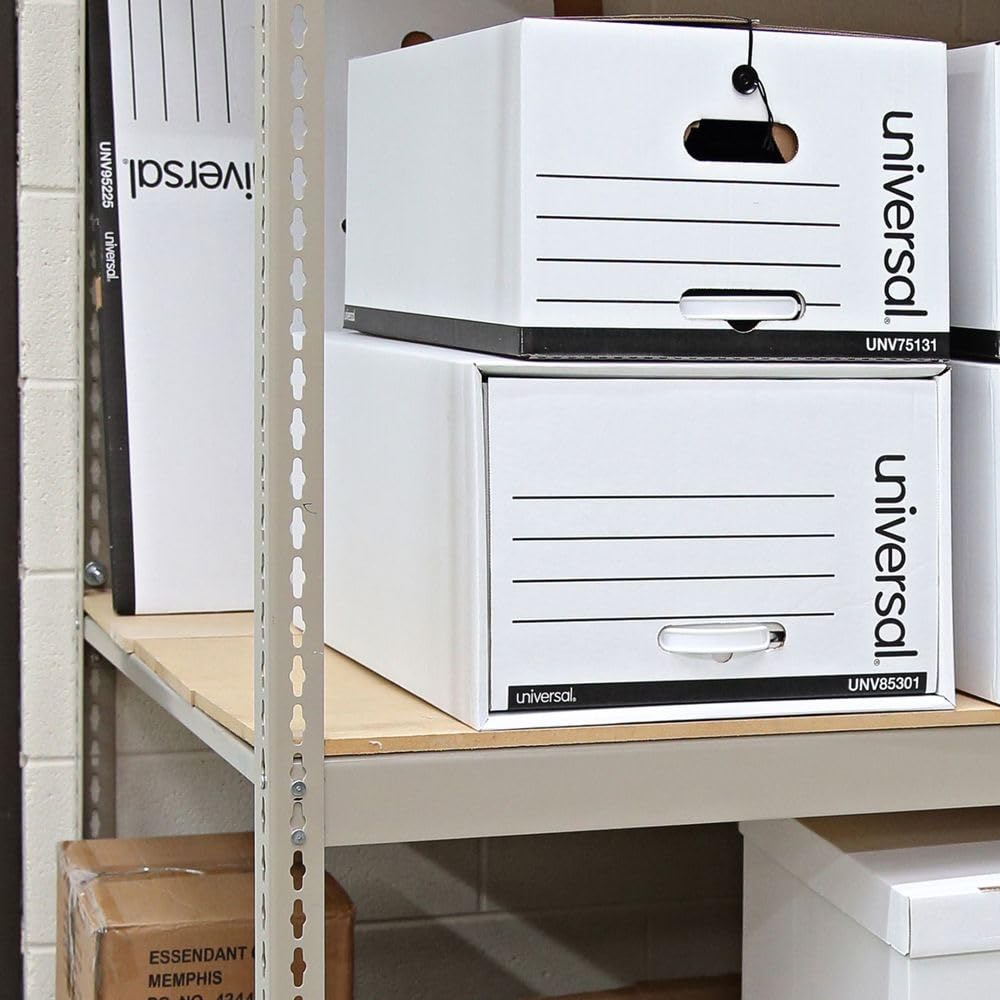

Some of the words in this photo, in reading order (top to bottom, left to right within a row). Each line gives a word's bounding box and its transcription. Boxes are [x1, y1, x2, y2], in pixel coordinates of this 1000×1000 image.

[99, 141, 114, 209] UNV95225
[129, 159, 255, 200] iversal
[882, 110, 929, 317] universal
[104, 231, 120, 279] universal
[865, 337, 937, 352] UNV75131
[874, 454, 919, 657] universal
[516, 687, 574, 705] universal
[848, 676, 920, 692] UNV85301
[149, 946, 247, 965] ESSENDANT
[148, 970, 222, 988] MEMPHIS
